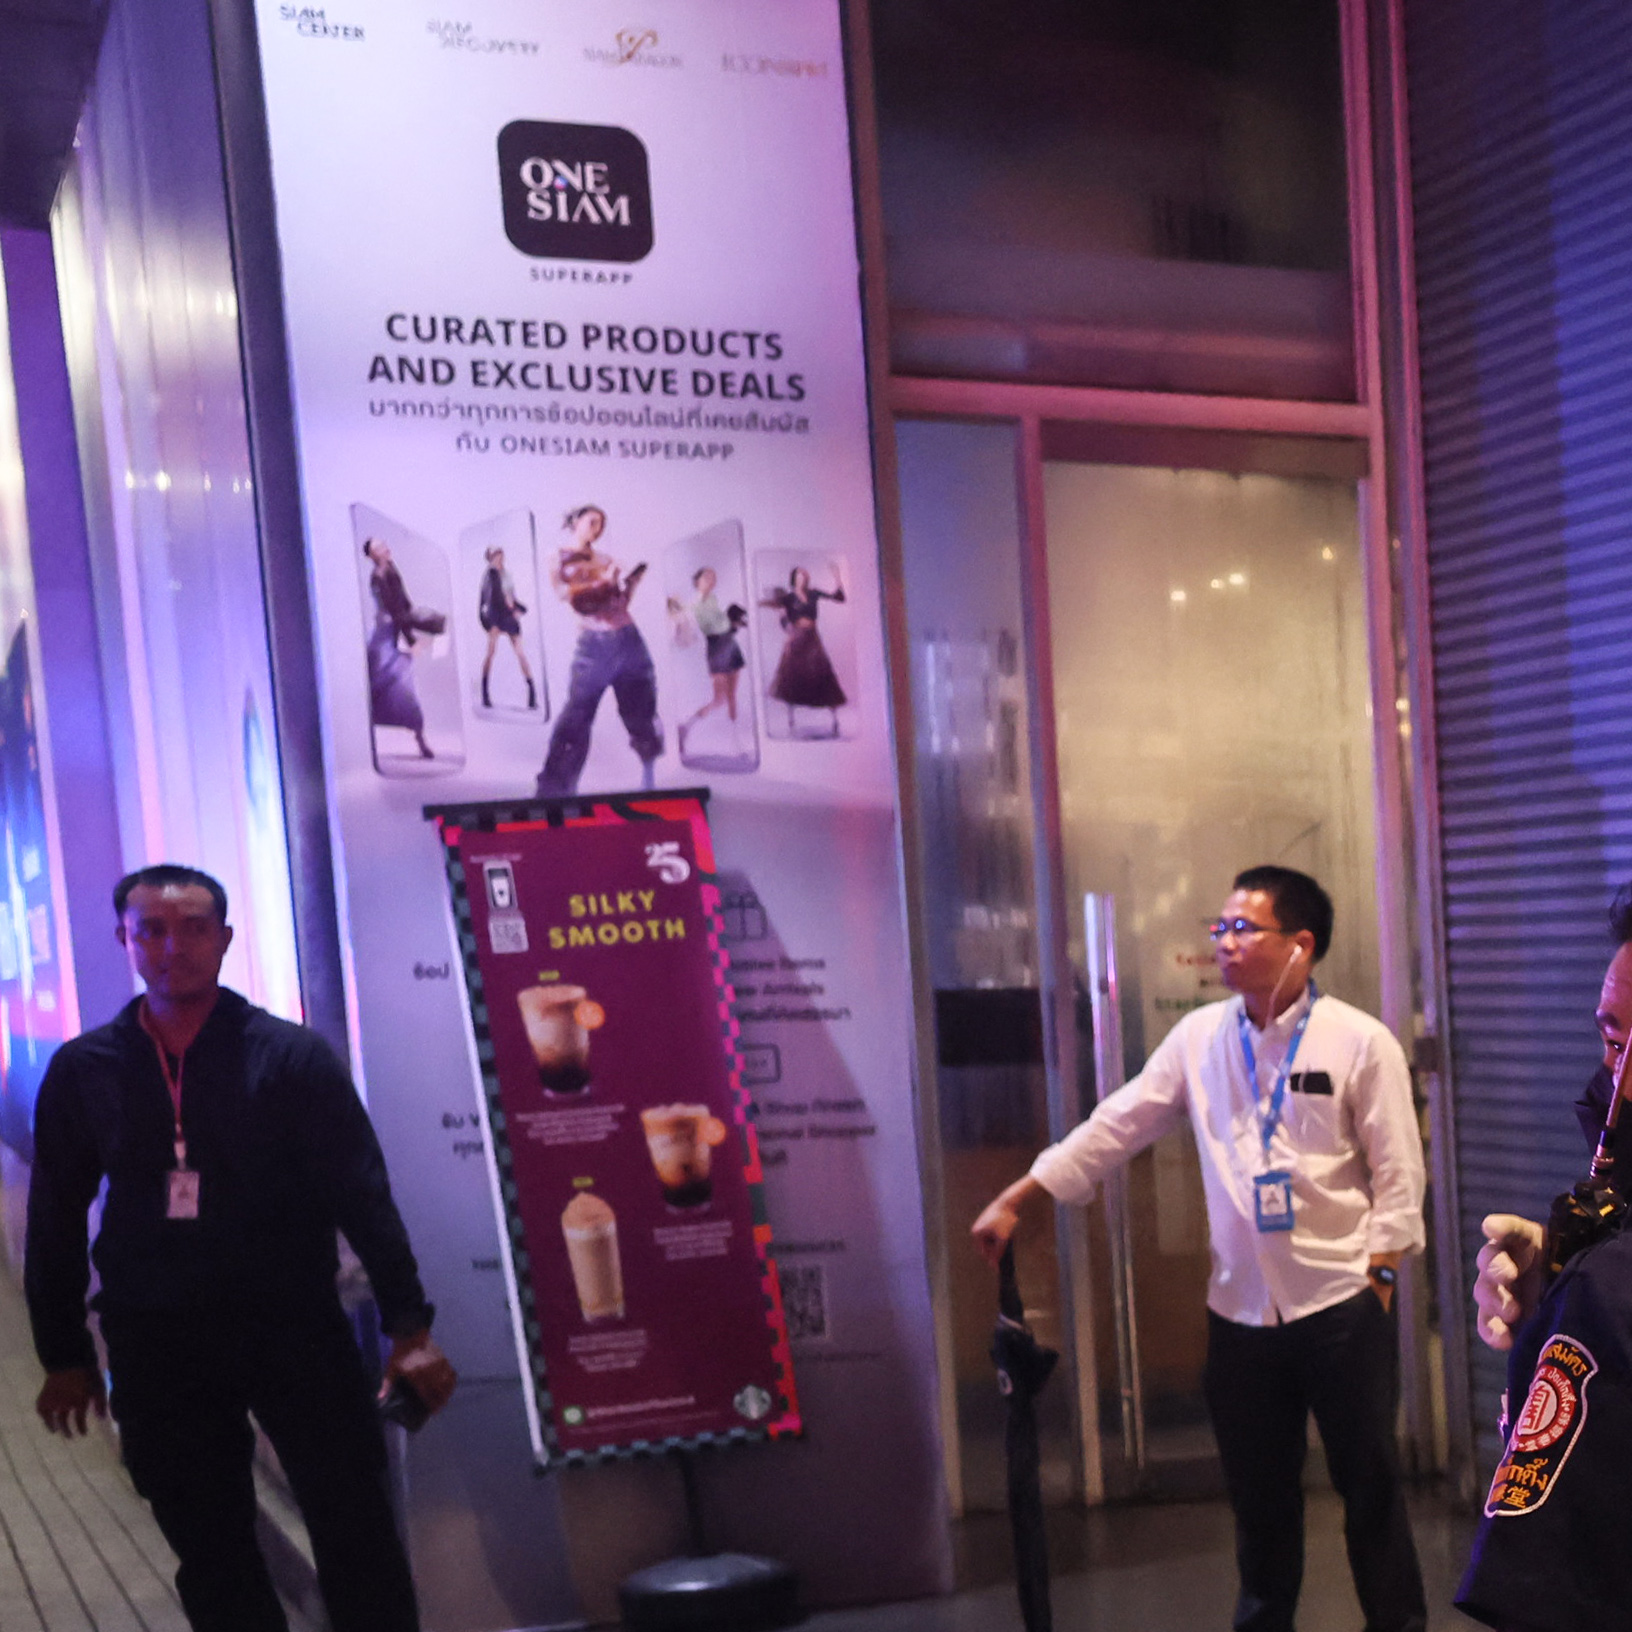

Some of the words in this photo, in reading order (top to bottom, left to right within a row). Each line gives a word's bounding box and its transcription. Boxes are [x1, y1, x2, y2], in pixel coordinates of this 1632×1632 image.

[519, 156, 610, 194] ONE
[527, 189, 631, 226] SIAM
[530, 267, 632, 284] SUPERAPP
[386, 313, 567, 349] CURATED
[582, 323, 783, 360] PRODUCTS
[368, 355, 456, 386] AND
[471, 359, 678, 396] EXCLUSIVE
[692, 369, 806, 401] DEALS
[501, 434, 611, 457] ONESIAM
[618, 439, 734, 460] SUPERAPP
[569, 890, 655, 918] SILKY
[549, 918, 686, 949] SMOOTH
[1492, 1484, 1533, 1510] 堂
